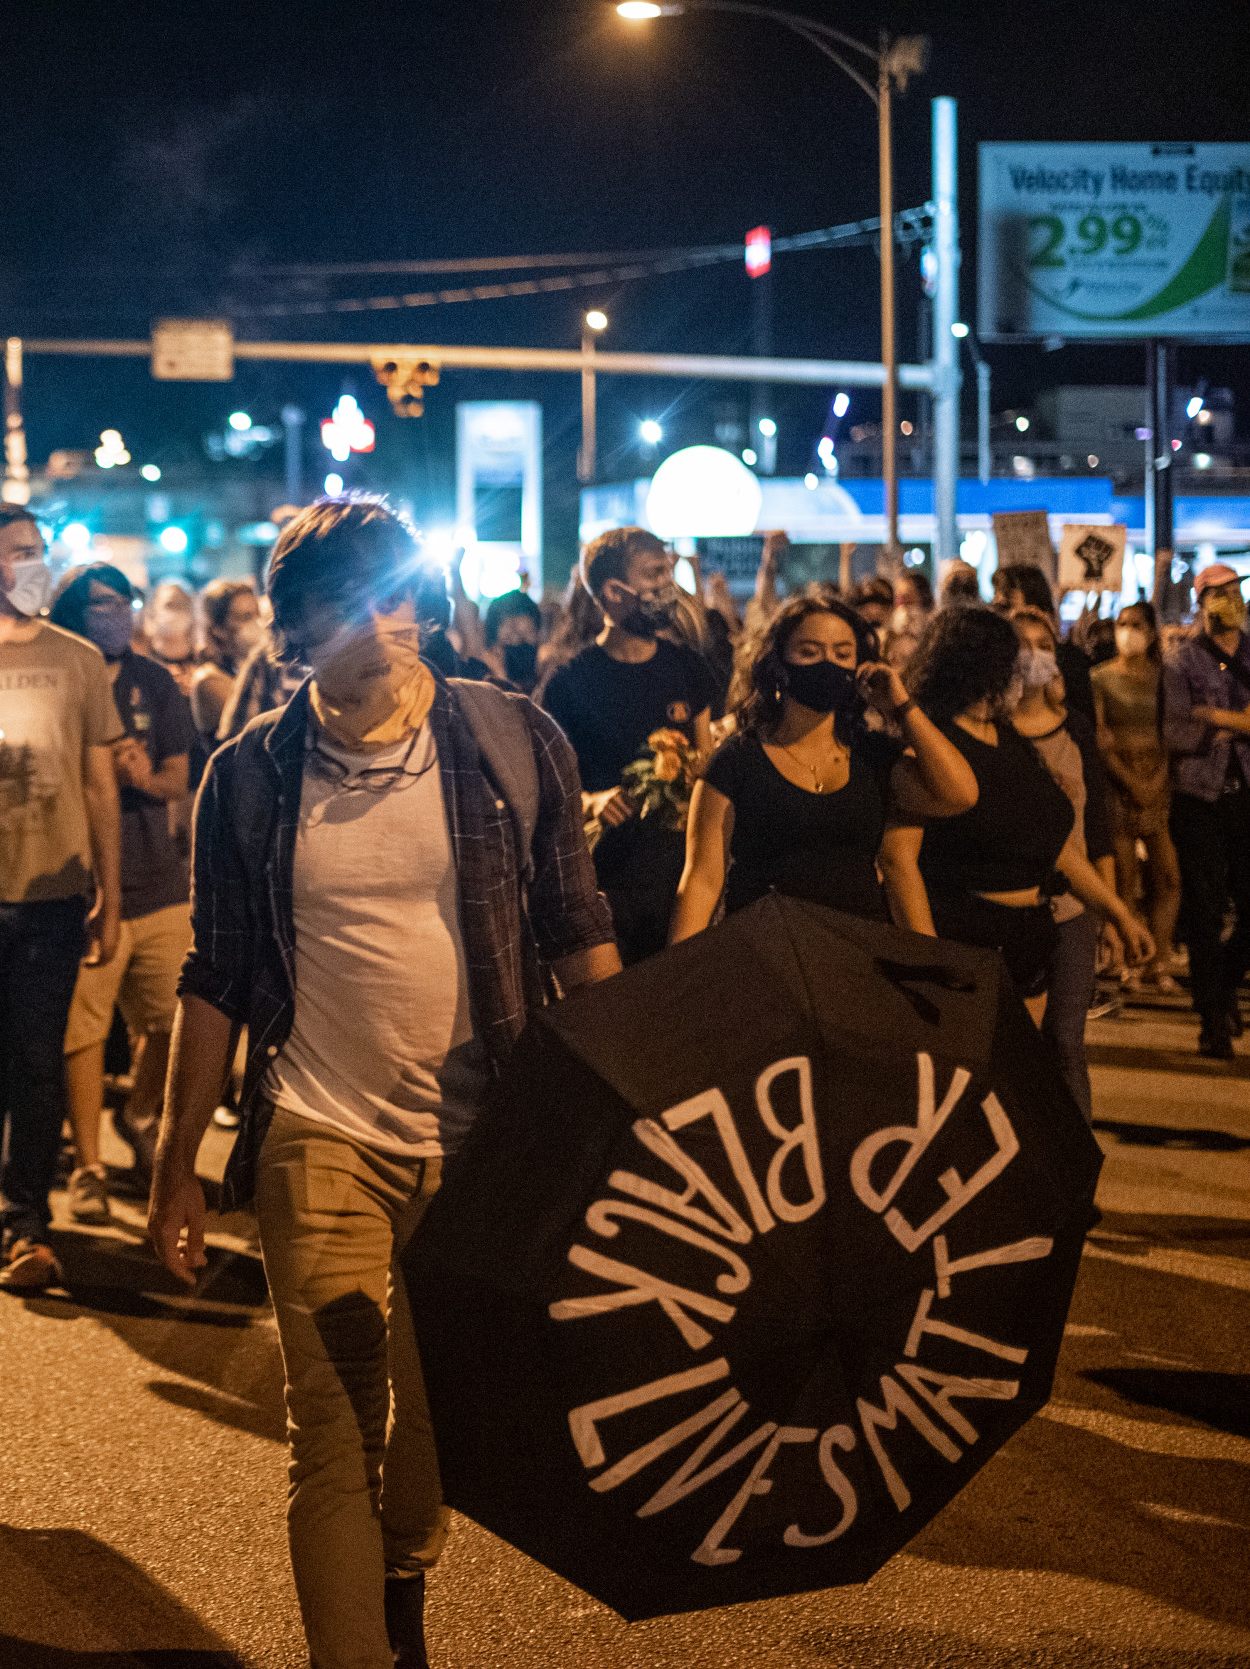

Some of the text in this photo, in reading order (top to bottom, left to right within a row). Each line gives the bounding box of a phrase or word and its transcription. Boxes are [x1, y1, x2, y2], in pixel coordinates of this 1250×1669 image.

[1009, 166, 1104, 197] Velocity
[1110, 165, 1178, 193] Home
[549, 1052, 1054, 1566] BLACK LIVES MATTER
